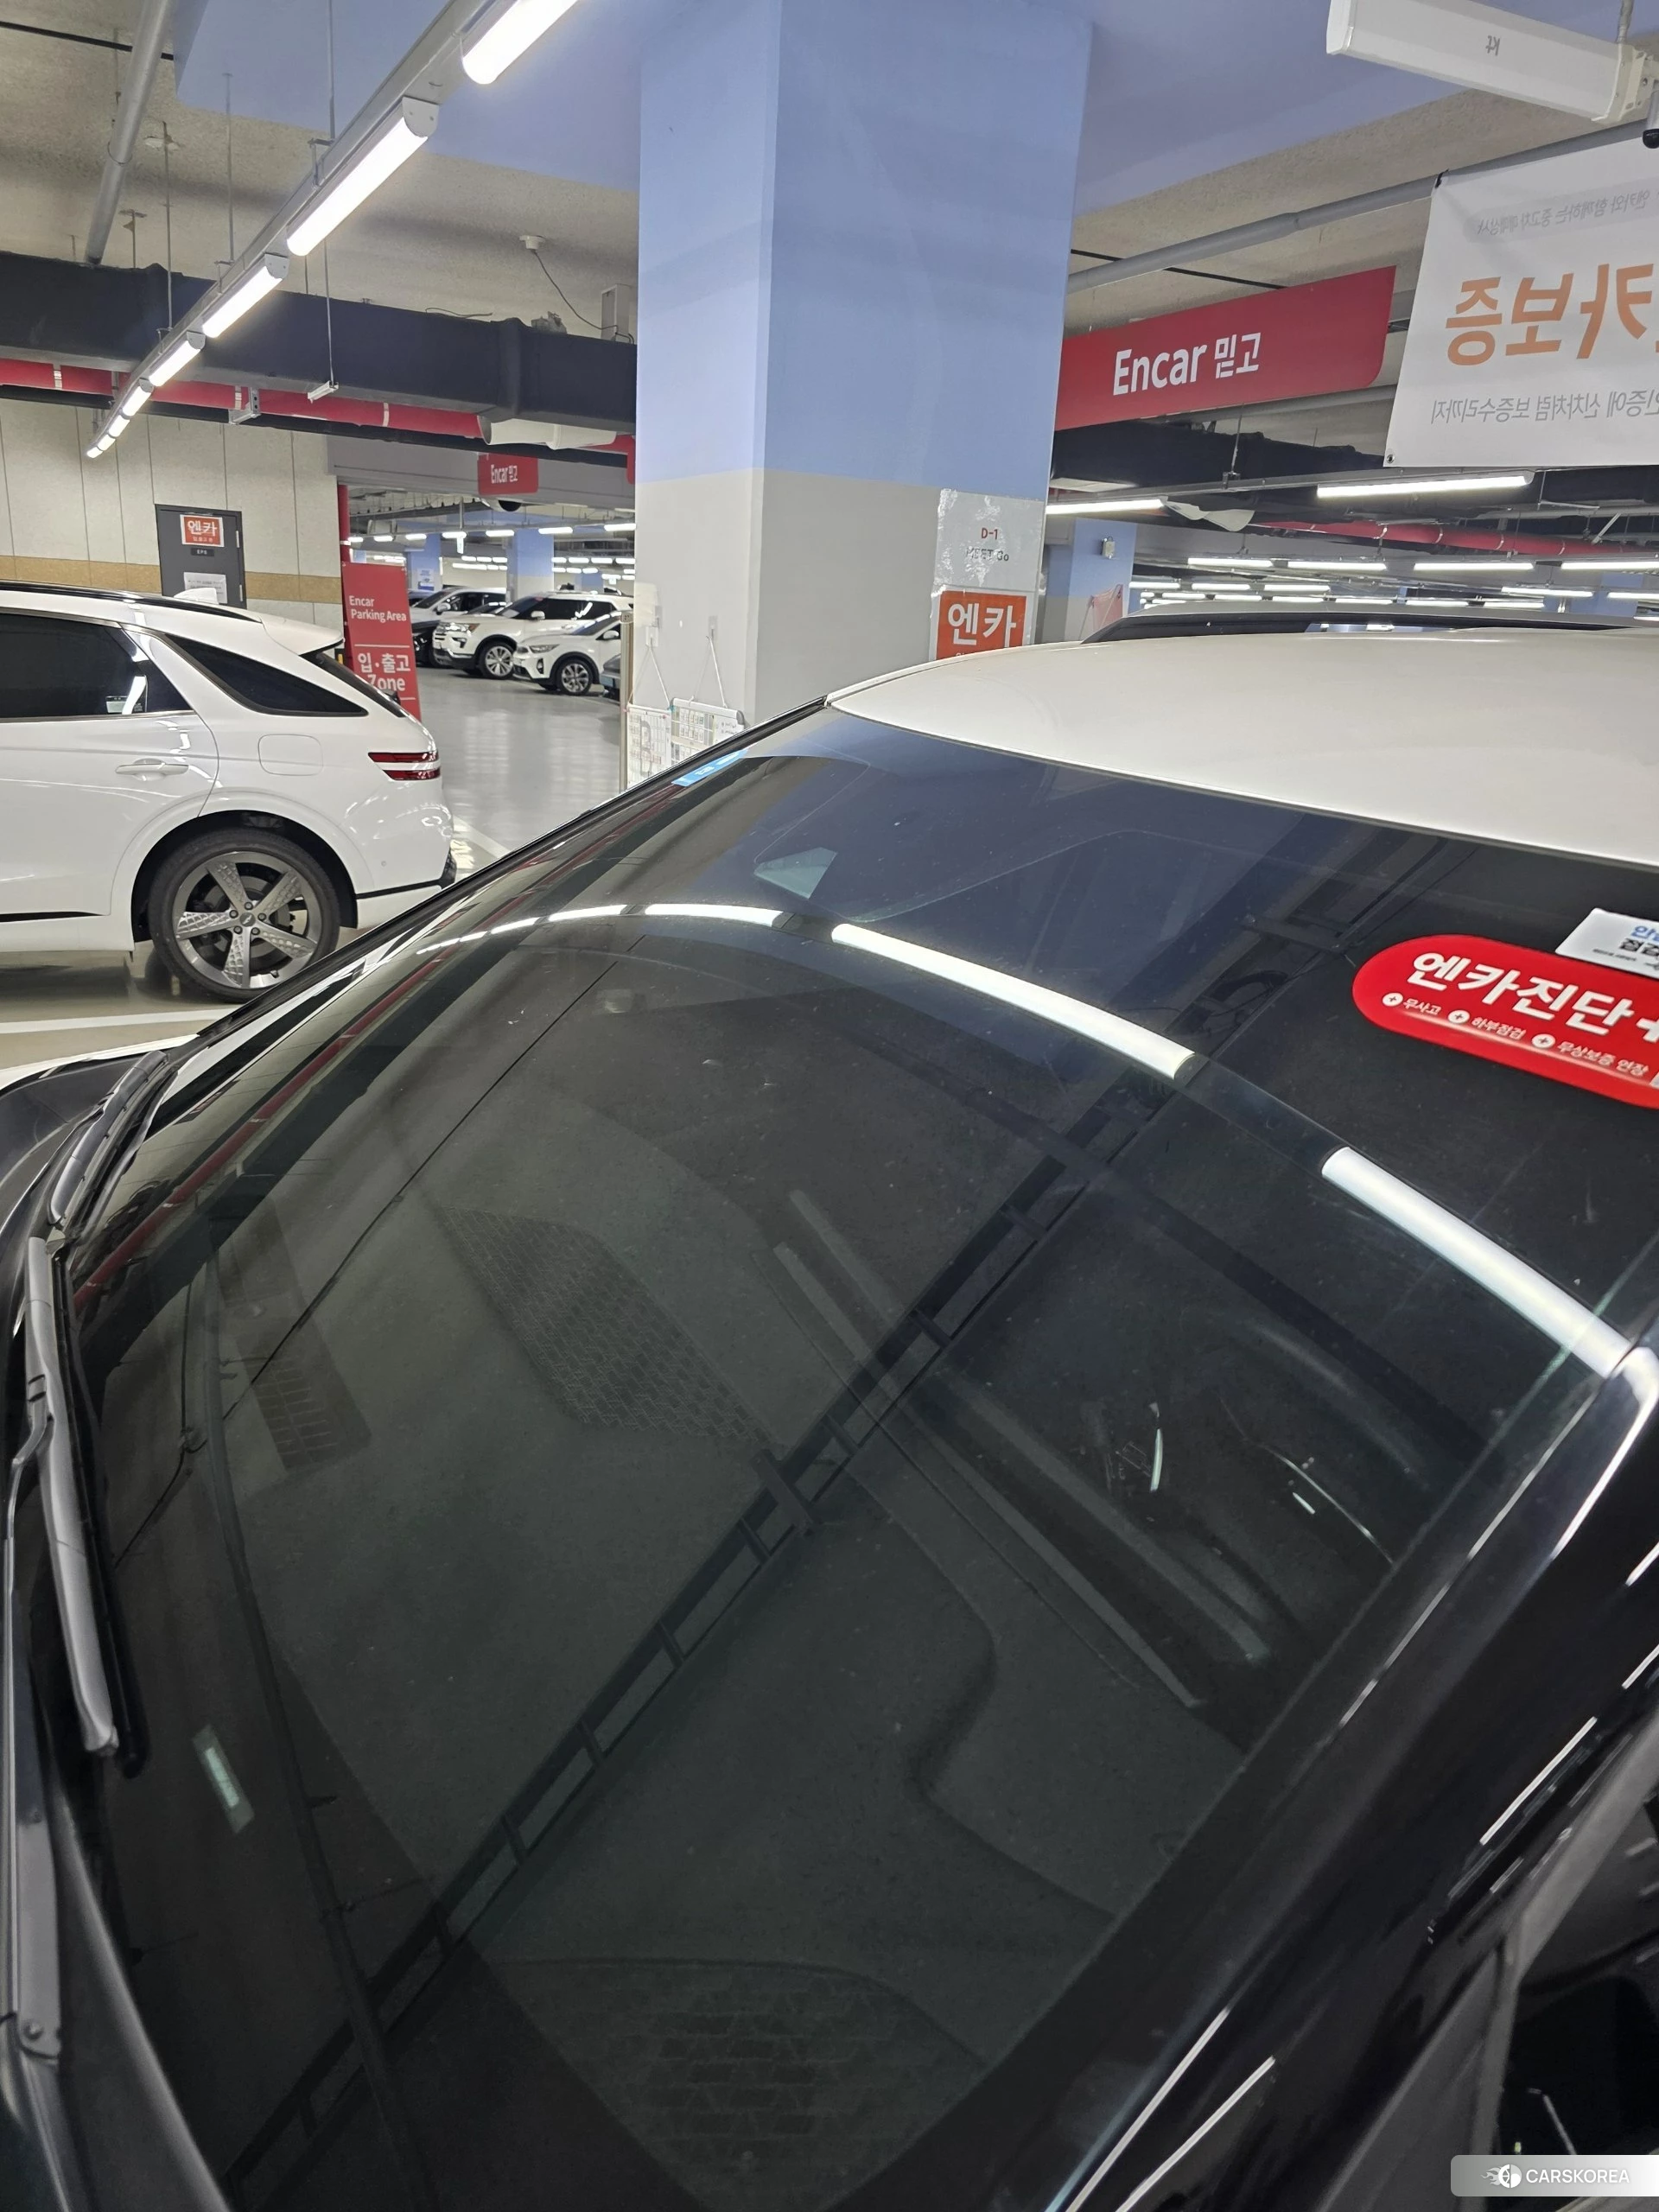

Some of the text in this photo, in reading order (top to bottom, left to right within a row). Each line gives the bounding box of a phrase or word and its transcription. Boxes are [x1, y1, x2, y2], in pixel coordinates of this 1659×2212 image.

[1113, 332, 1262, 396] Encar 믿고
[491, 464, 508, 484] Encar
[188, 520, 218, 537] 엔카
[981, 527, 998, 540] D-1
[349, 595, 374, 607] Encar
[351, 609, 407, 623] Parking Area
[948, 602, 1016, 647] 엔카
[1403, 998, 1442, 1015] 무사고
[1471, 1017, 1527, 1040] 하부점검
